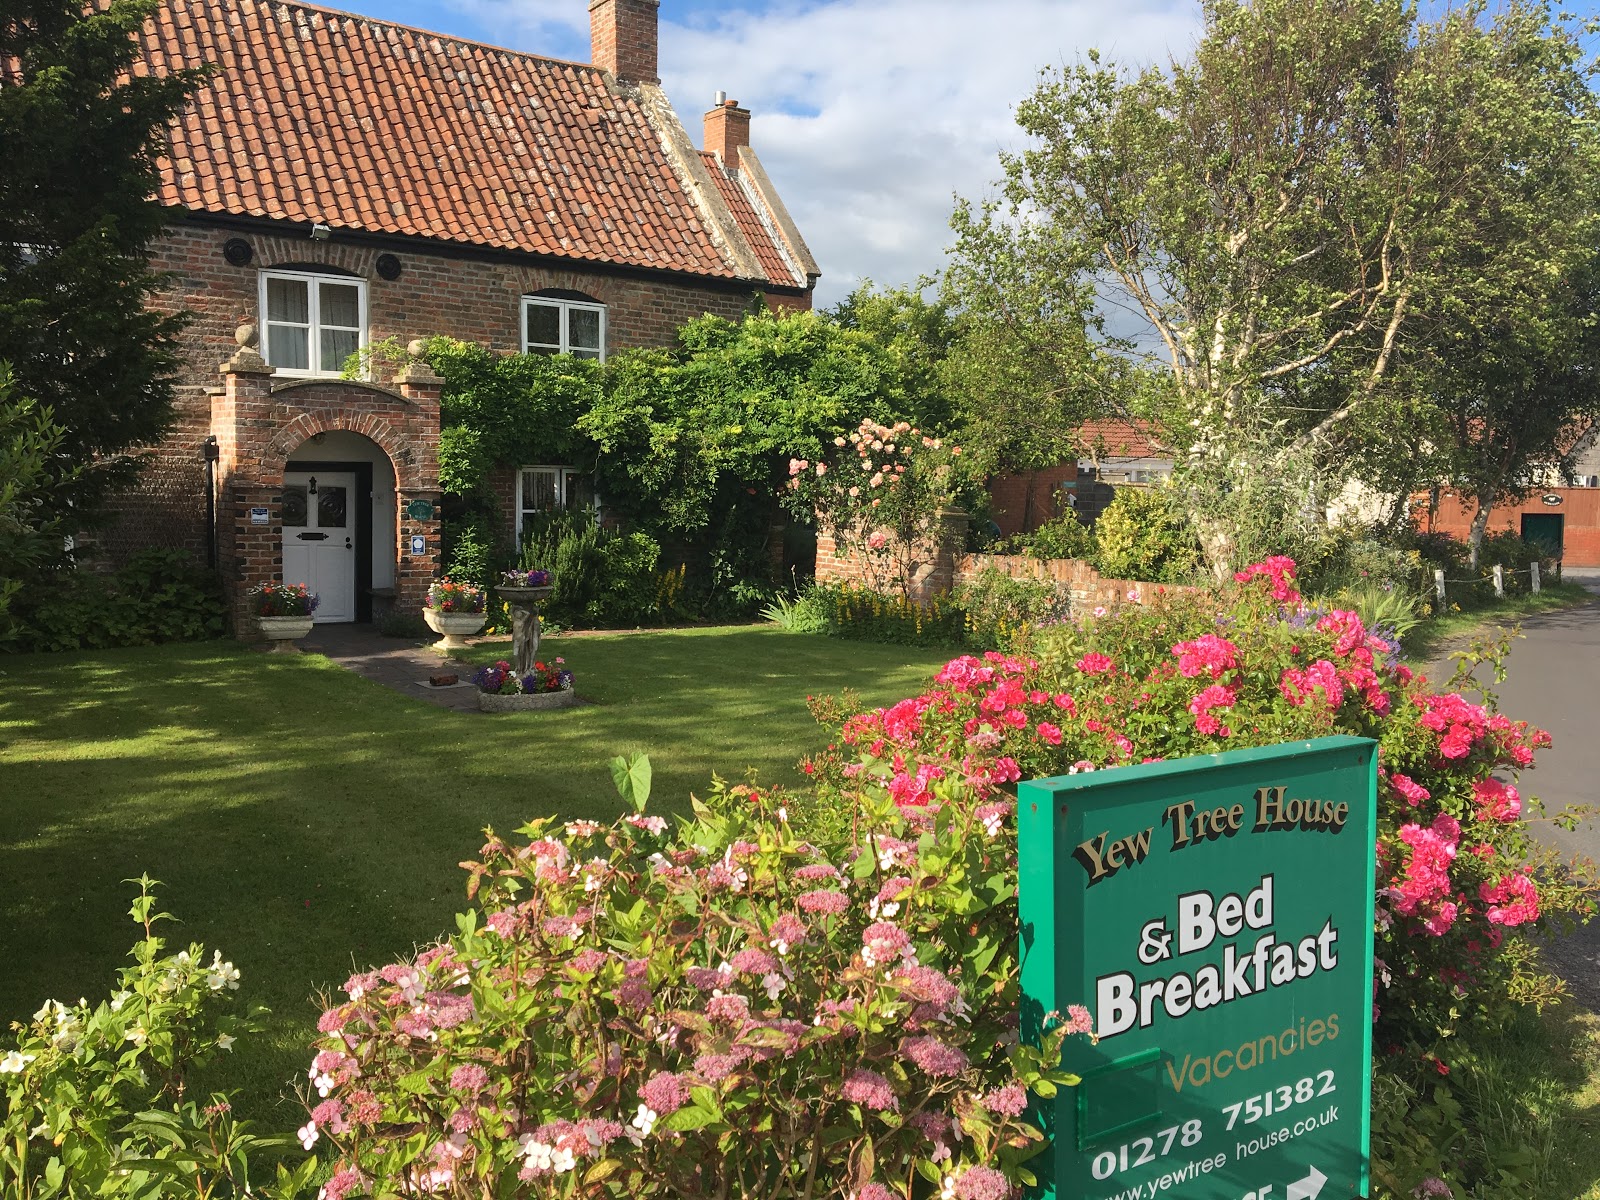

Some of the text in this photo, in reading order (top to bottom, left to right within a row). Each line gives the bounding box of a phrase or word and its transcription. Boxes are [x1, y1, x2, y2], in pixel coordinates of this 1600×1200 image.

[1072, 785, 1349, 888] Yew Tree House
[1137, 873, 1275, 966] & Bed
[1096, 914, 1339, 1041] Breakfast
[1166, 1013, 1340, 1093] Vacancies
[1091, 1069, 1337, 1181] 01278 751382
[1104, 1104, 1340, 1200] w.yewtree house.co.uk
